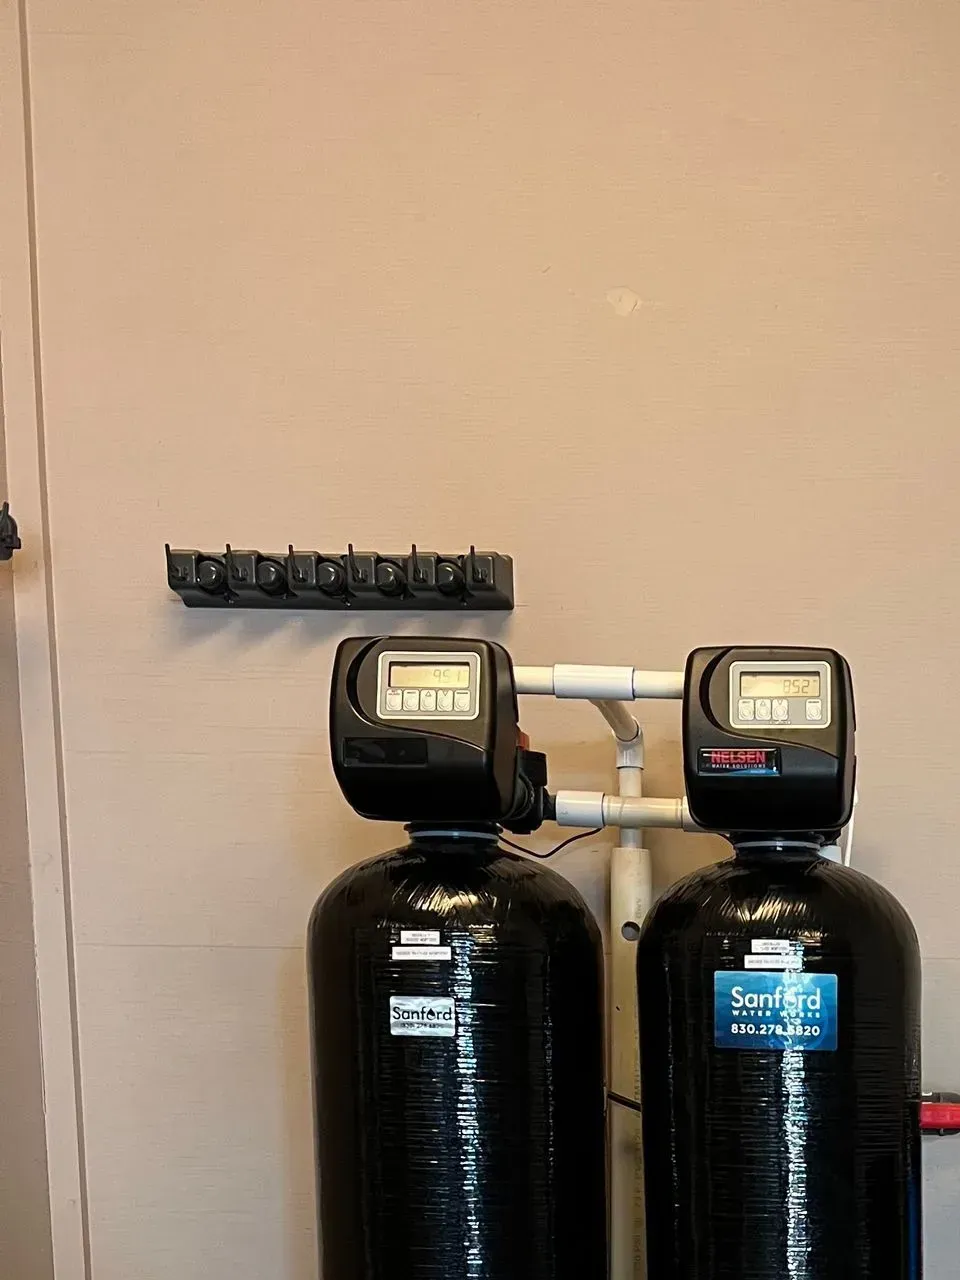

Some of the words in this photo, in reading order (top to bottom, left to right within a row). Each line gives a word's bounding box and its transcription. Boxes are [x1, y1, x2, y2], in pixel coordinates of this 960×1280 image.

[711, 751, 766, 764] NELSEN
[731, 986, 821, 1010] Sanford
[392, 1006, 452, 1021] Sanford
[780, 1010, 821, 1019] WORKS
